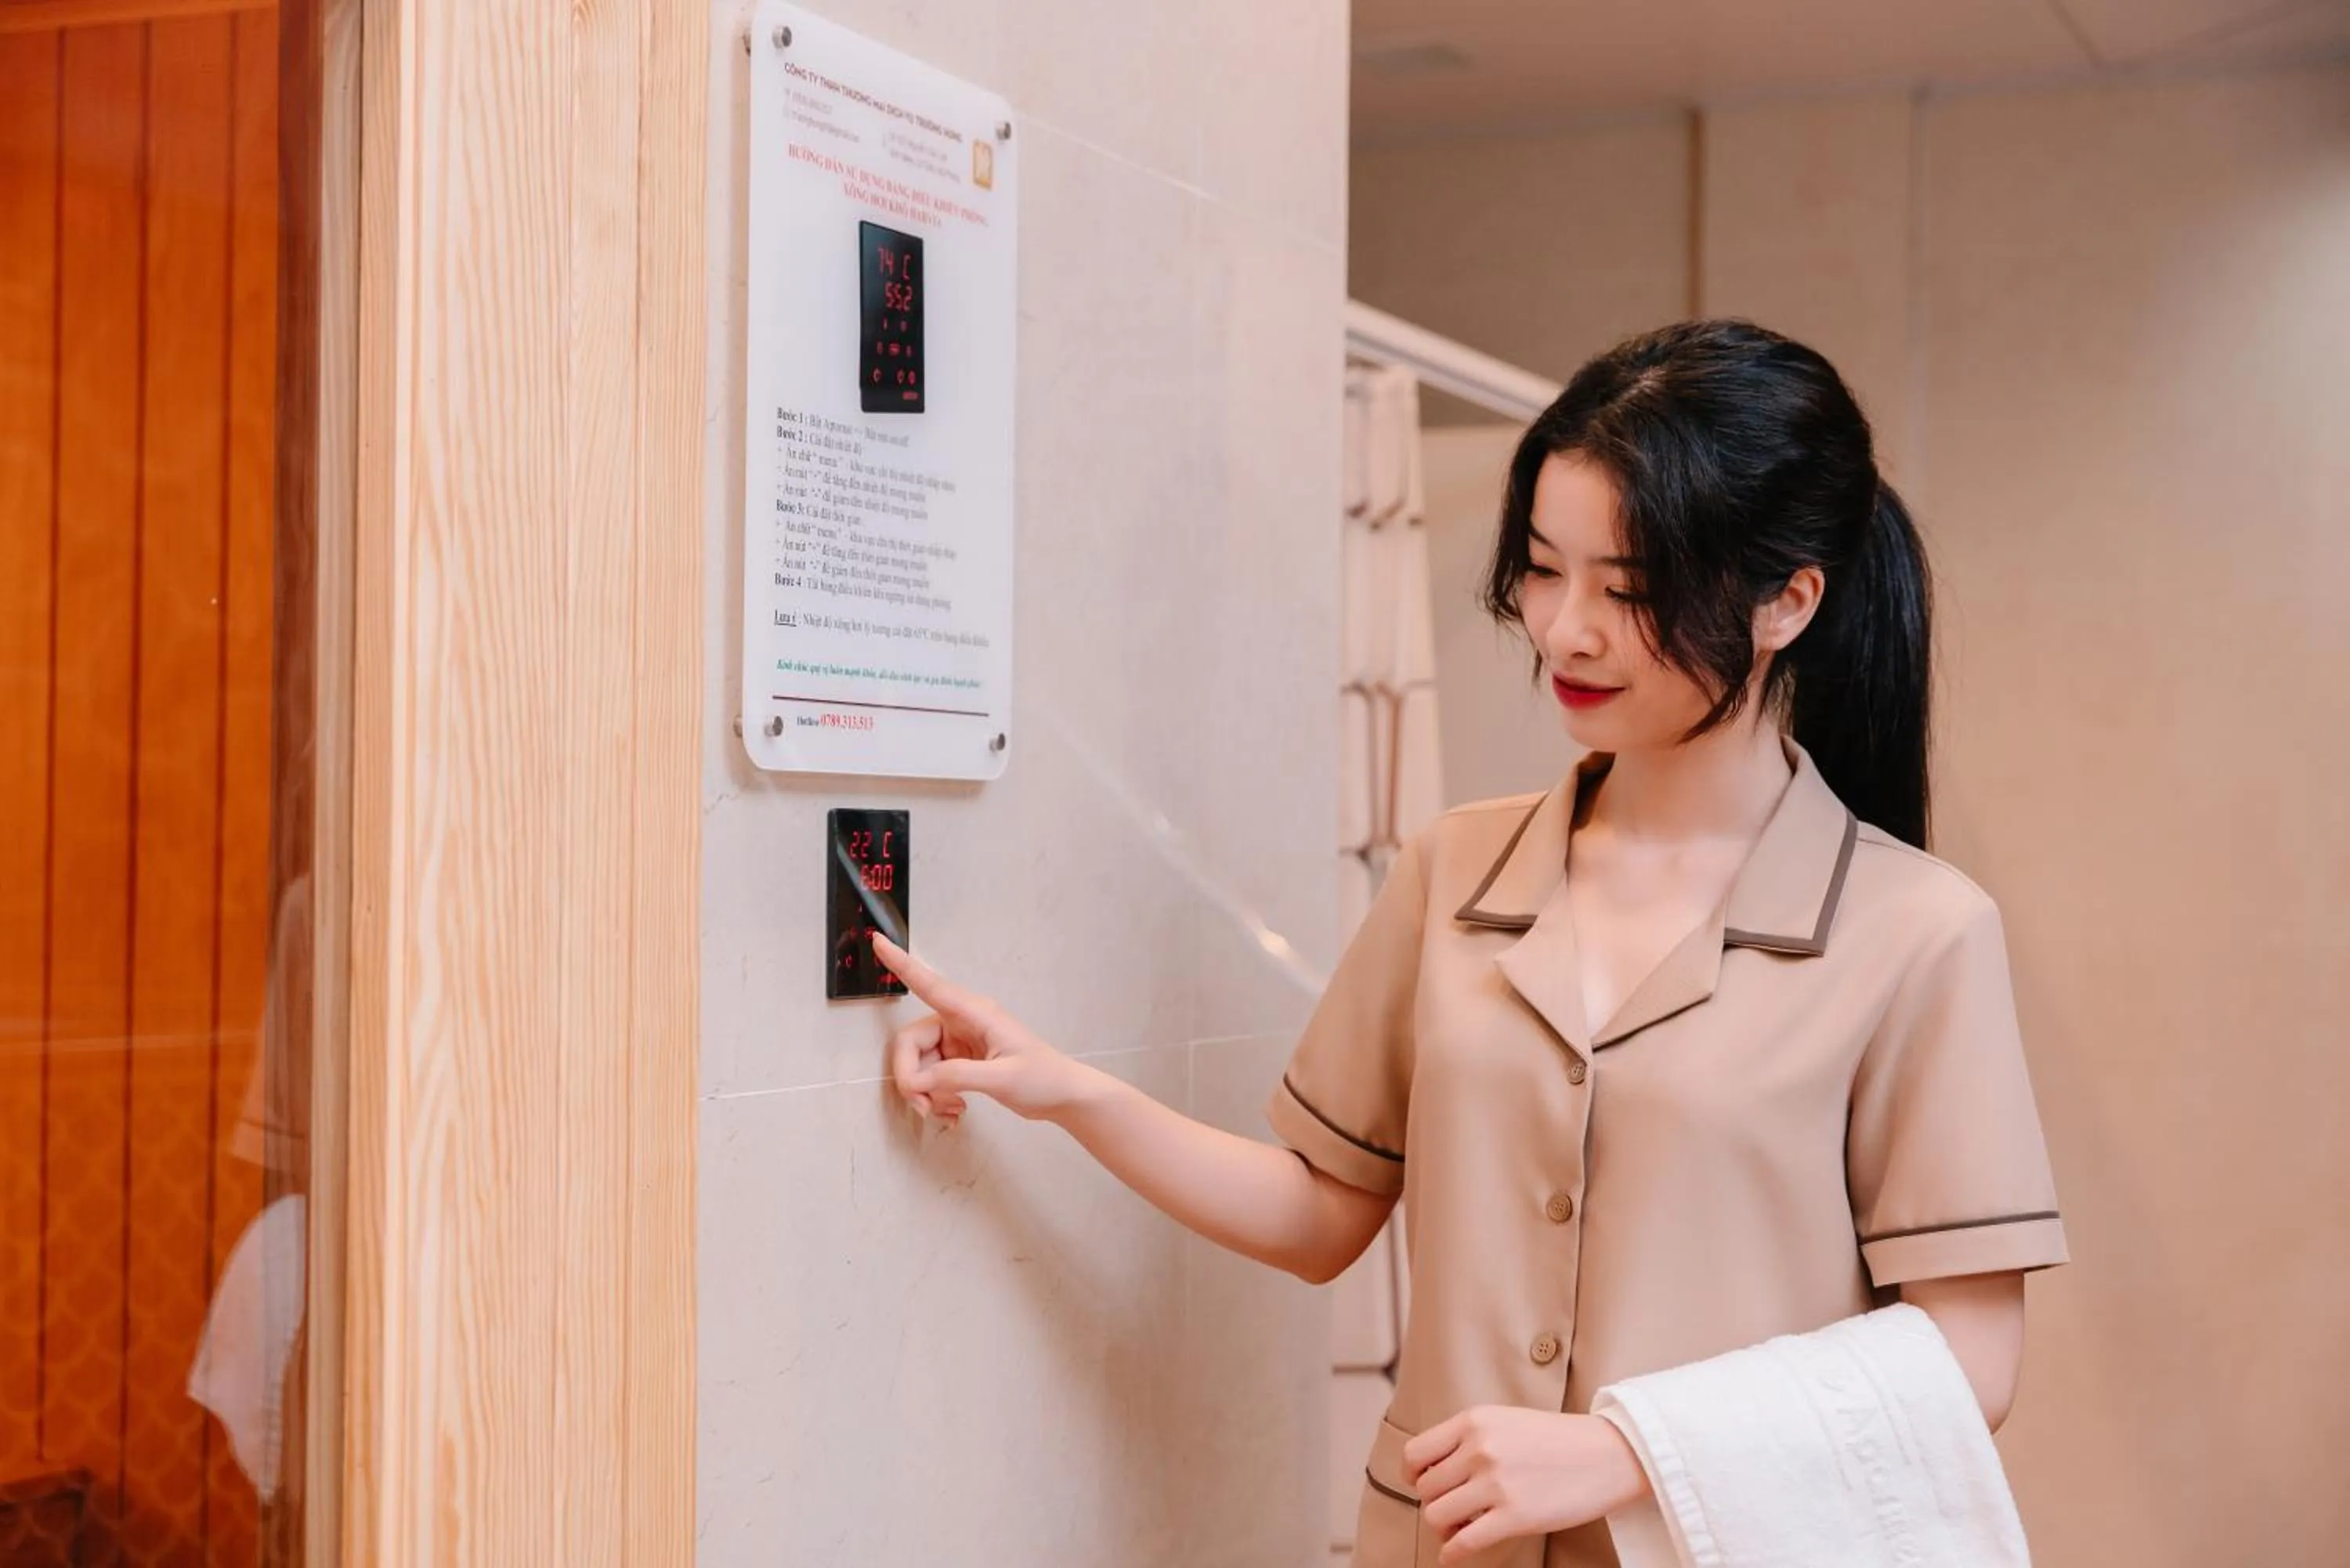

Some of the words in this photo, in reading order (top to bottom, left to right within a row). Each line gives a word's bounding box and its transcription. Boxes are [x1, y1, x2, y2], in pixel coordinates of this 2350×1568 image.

[808, 72, 817, 85] TY
[850, 830, 873, 859] 22
[882, 830, 893, 858] C
